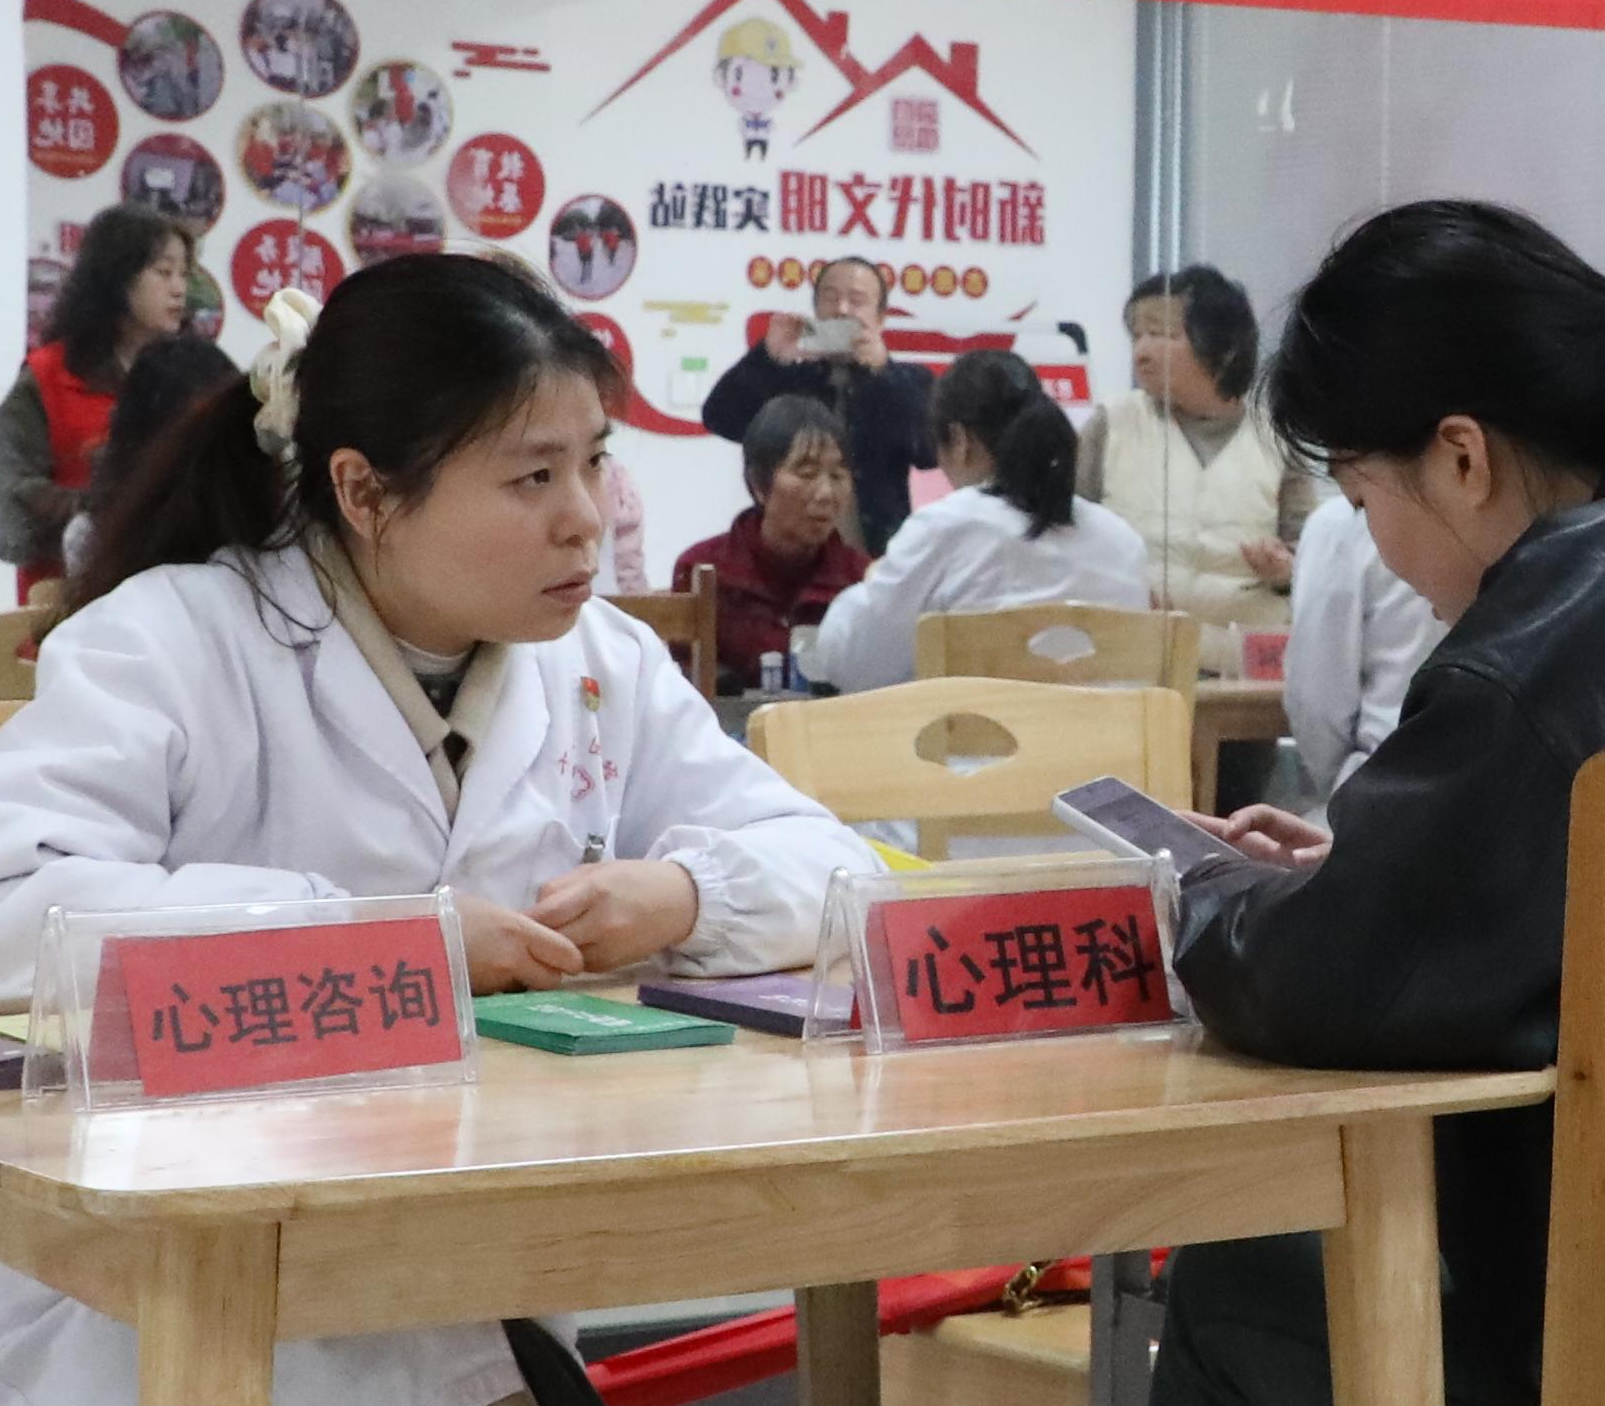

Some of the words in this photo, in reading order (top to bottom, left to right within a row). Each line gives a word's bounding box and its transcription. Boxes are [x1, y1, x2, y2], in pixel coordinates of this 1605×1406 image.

[151, 957, 441, 1055] 心理咨询
[905, 913, 1157, 1016] 心理科
